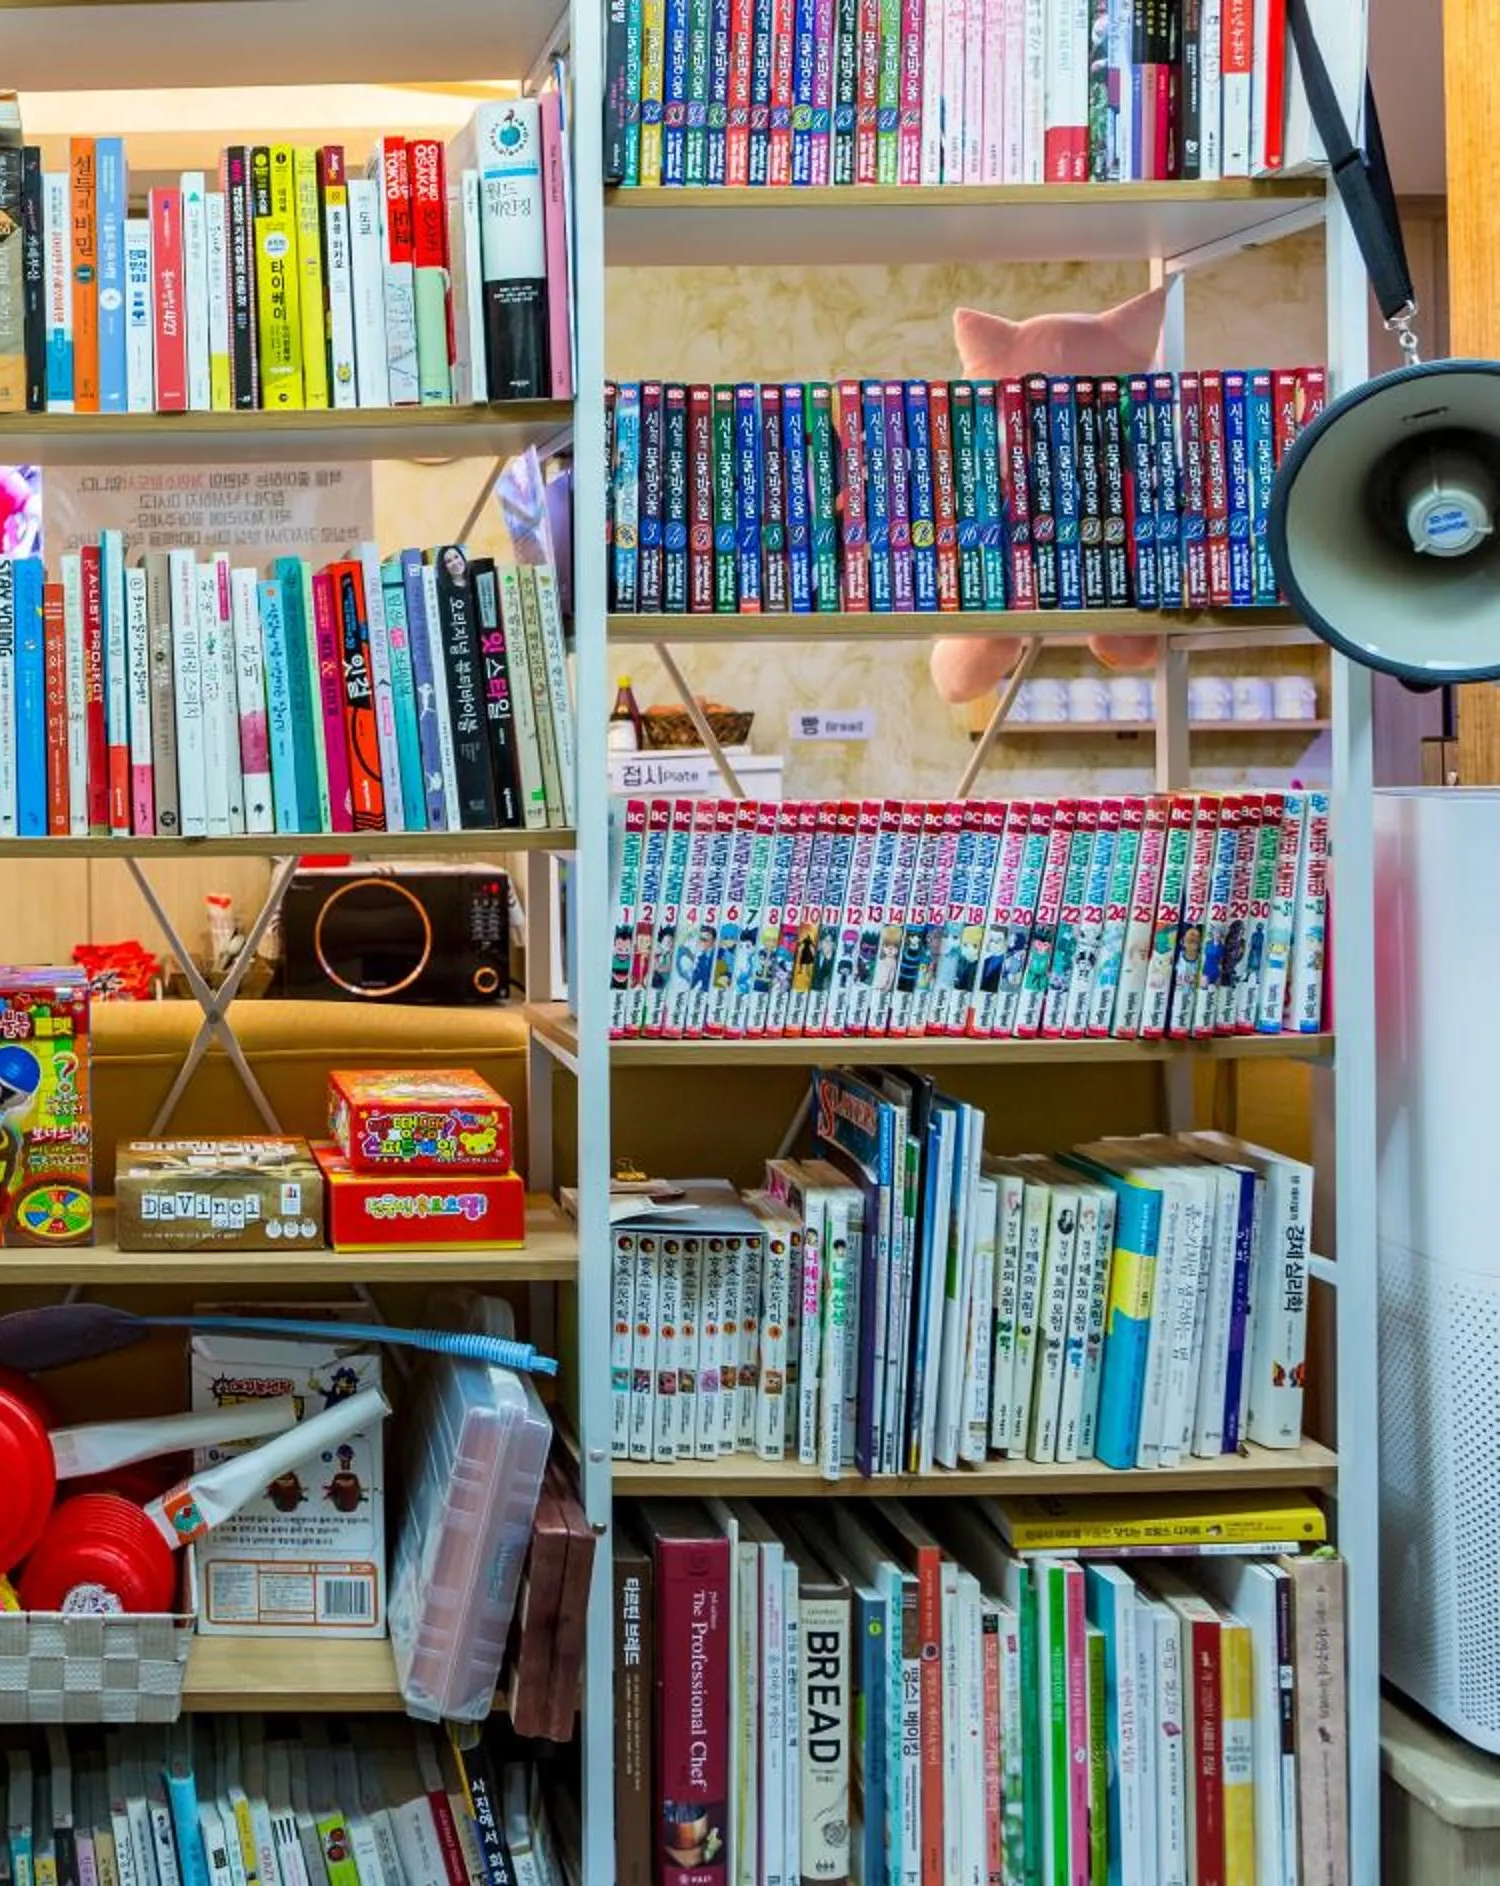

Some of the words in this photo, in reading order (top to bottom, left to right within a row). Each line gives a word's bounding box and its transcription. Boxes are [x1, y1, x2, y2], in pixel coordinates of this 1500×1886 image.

[384, 149, 401, 200] TOKYO
[414, 146, 428, 202] OSAKA
[270, 260, 287, 320] 타이베이
[449, 597, 468, 655] 오리지널
[480, 631, 506, 653] 잇
[90, 630, 103, 703] PROJECT
[455, 659, 479, 734] 뷰티바이블
[485, 657, 511, 720] 스타일
[623, 765, 663, 786] 접시
[663, 770, 699, 783] Plate
[627, 810, 645, 824] BC
[651, 810, 668, 823] BC
[717, 810, 735, 823] BC
[1171, 808, 1192, 821] BC
[622, 908, 630, 923] 1
[665, 906, 675, 922] 3
[705, 907, 717, 922] 5
[747, 910, 758, 924] 7
[769, 908, 780, 924] 8
[802, 905, 820, 922] 10
[846, 908, 863, 924] 12
[867, 905, 883, 921] 13
[928, 907, 944, 922] 16
[1011, 909, 1033, 925] 20
[1038, 905, 1056, 921] 21
[1085, 906, 1104, 924] 23
[1134, 906, 1152, 923] 25
[1250, 902, 1270, 918] 30
[143, 1193, 260, 1218] DaVinci
[1285, 1226, 1306, 1258] 경제
[1284, 1262, 1305, 1313] 심리학
[623, 1577, 641, 1620] 타르틴
[693, 1590, 706, 1616] The
[623, 1624, 641, 1666] 브레드
[691, 1621, 709, 1735] Professional
[806, 1631, 841, 1763] BREAD
[902, 1711, 920, 1757] 베이킹
[691, 1740, 709, 1788] Chef
